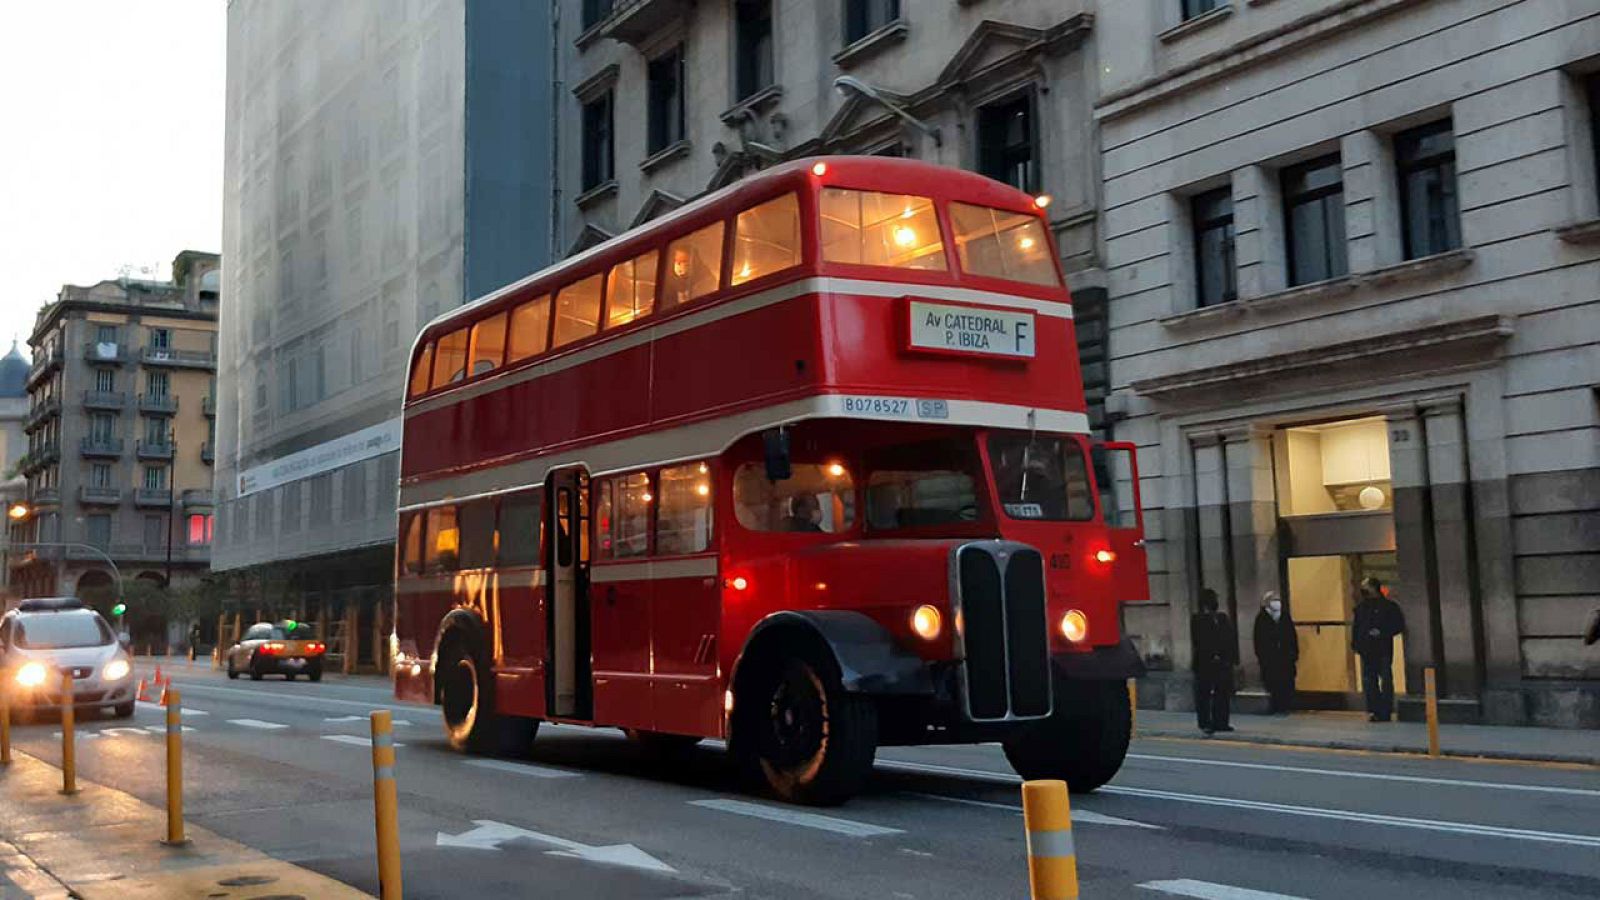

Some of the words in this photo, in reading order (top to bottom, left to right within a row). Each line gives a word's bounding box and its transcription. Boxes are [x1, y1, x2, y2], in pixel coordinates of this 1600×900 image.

[926, 311, 941, 327] Av
[944, 314, 1007, 335] CATEDRAL
[945, 331, 955, 346] P.
[958, 333, 990, 349] IBIZA
[1014, 321, 1028, 352] F
[921, 400, 946, 415] SP
